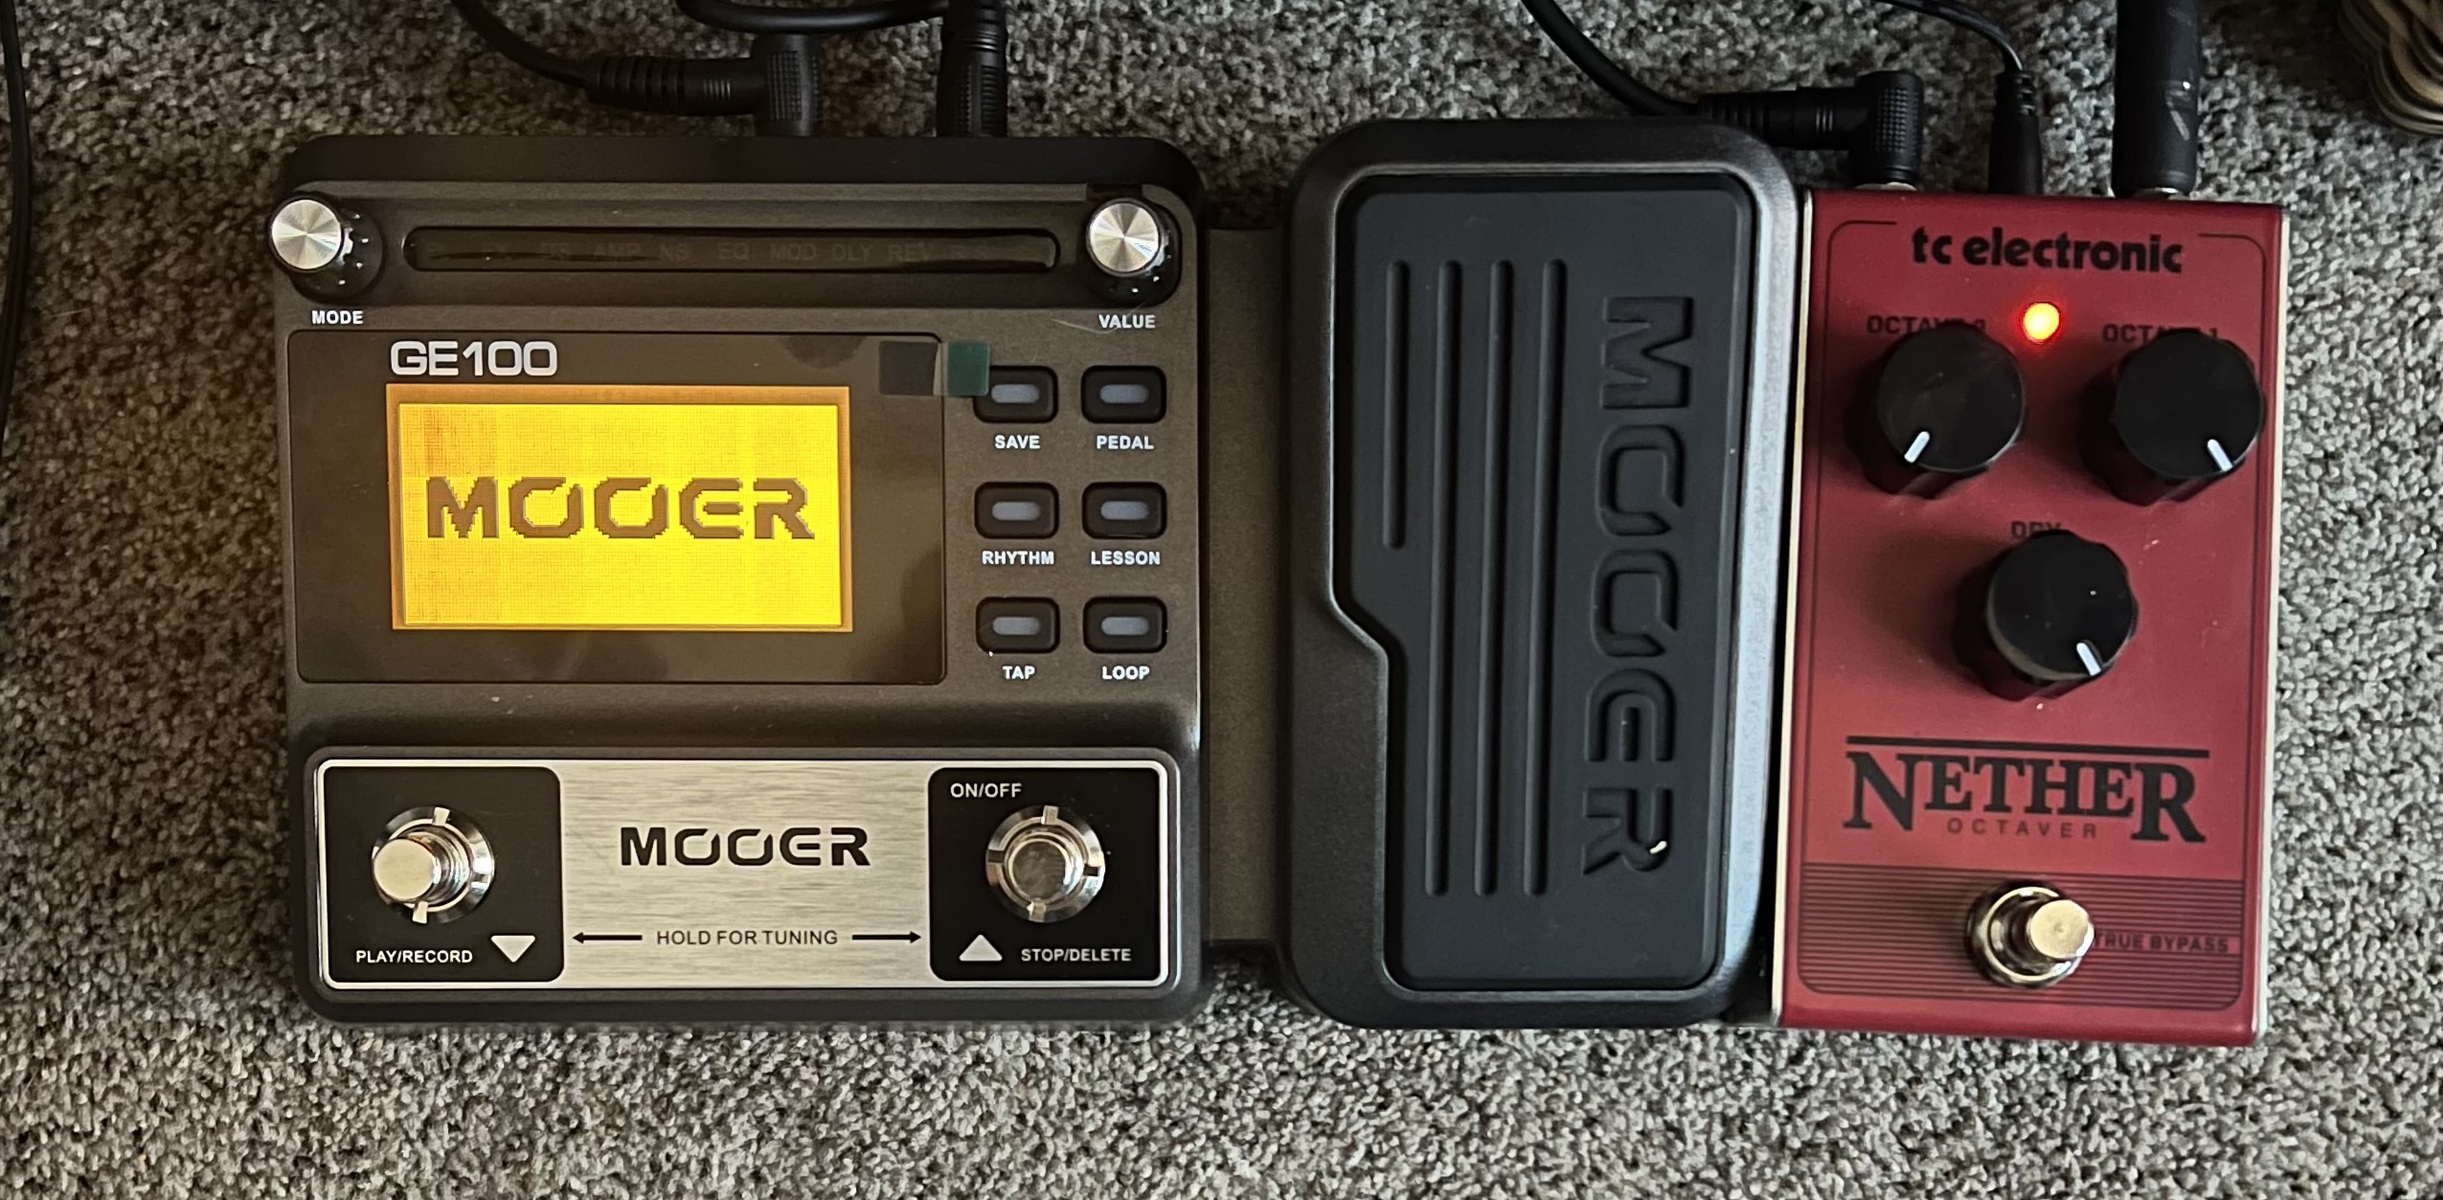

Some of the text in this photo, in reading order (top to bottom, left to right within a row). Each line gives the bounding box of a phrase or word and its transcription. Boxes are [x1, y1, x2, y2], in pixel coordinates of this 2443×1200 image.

[718, 242, 751, 262] EQ
[769, 243, 818, 262] MOD
[1913, 227, 2183, 273] tc electronic
[311, 310, 363, 325] MODE
[1098, 314, 1156, 329] VALUE
[390, 340, 557, 376] GE100
[994, 435, 1040, 449] SAVE
[1096, 435, 1154, 450] PEDAL
[425, 476, 815, 540] MOOER
[981, 551, 1054, 565] RHYTHM
[1091, 551, 1160, 565] LESSON
[1582, 295, 1695, 877] MOOER
[1002, 666, 1035, 680] TAP
[1102, 666, 1150, 680] LOOP
[950, 783, 1022, 799] ON/OFF
[1843, 750, 2206, 844] NETHER
[1947, 816, 2098, 840] OCTAVER
[620, 827, 871, 867] MOOER
[656, 930, 838, 946] HOLD FOR TUNING
[2094, 931, 2229, 953] TRUE BYPASS
[355, 949, 473, 964] PLAY/RECORD
[1021, 947, 1131, 963] STOP/DELETE
